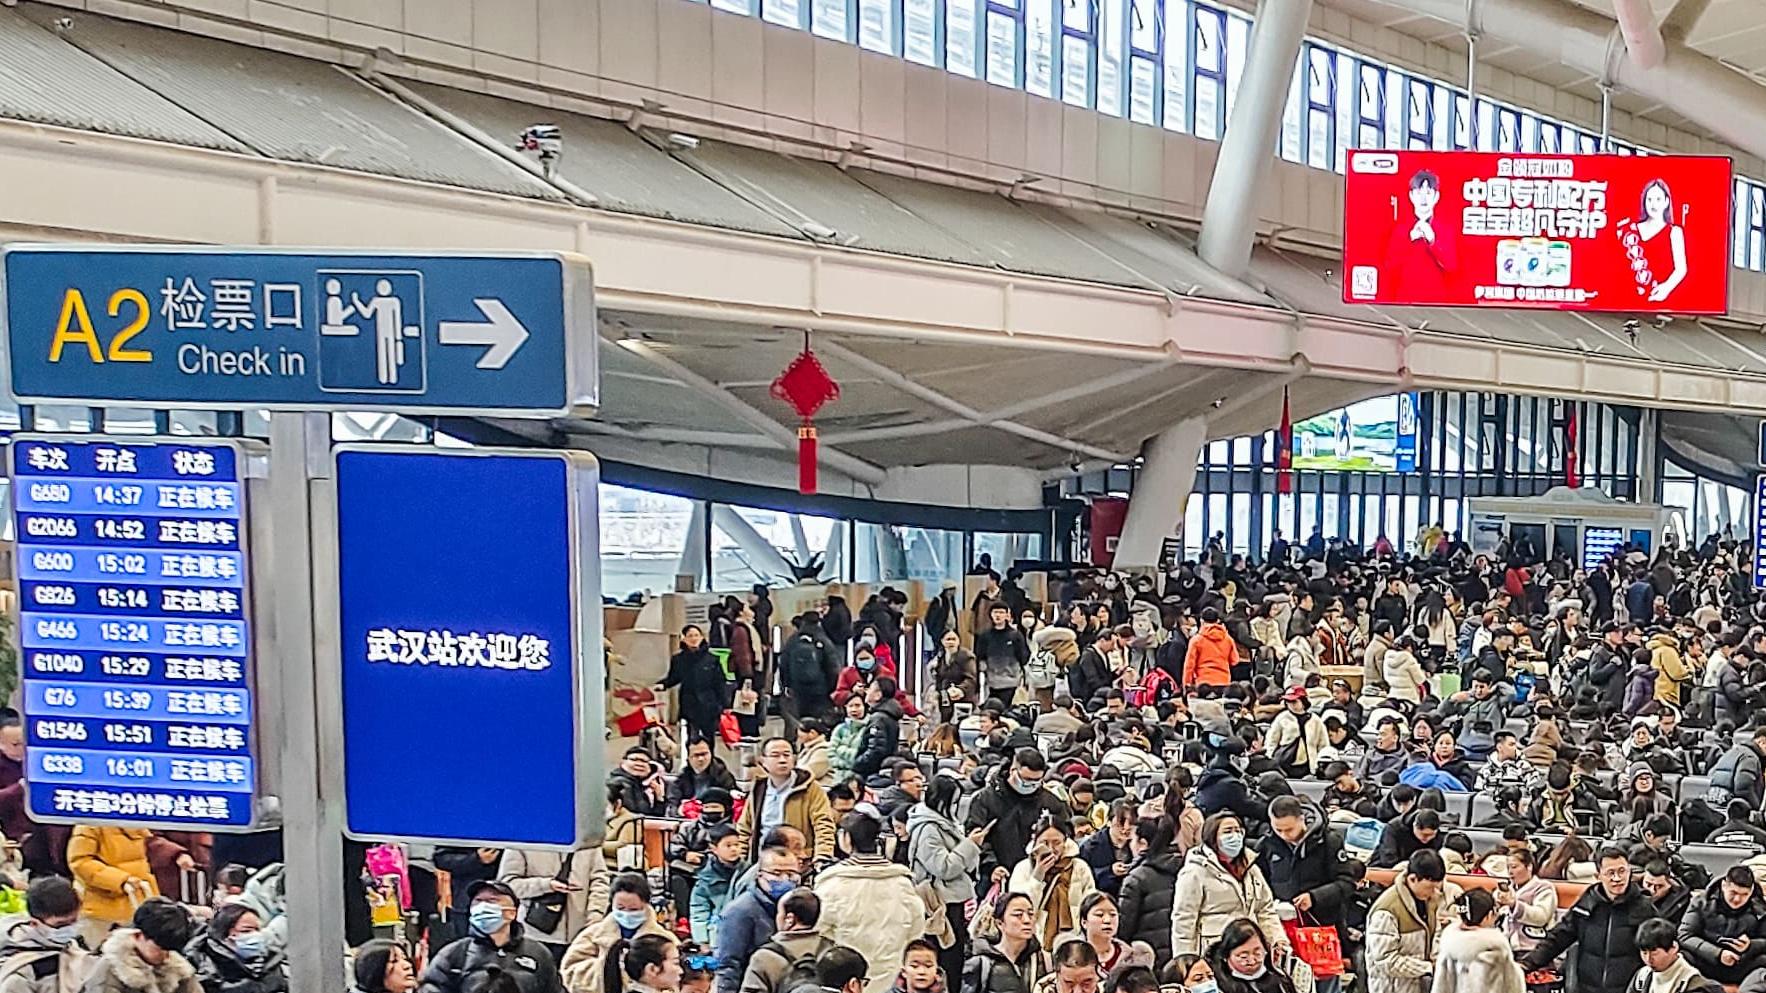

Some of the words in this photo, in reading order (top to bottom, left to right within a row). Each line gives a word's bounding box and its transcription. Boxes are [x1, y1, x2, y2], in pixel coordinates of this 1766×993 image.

[1463, 178, 1608, 210] 中国专利配方
[49, 288, 153, 363] A2
[160, 277, 303, 331] 检票口
[178, 343, 271, 375] Check
[279, 346, 305, 375] in
[28, 447, 69, 470] 车次
[96, 448, 137, 473] 开点
[172, 450, 215, 475] 状态
[94, 486, 143, 505] 14:37
[95, 519, 146, 539] 14:52
[97, 554, 146, 573] 15:02
[98, 588, 149, 608] 15:14
[101, 623, 149, 642] 15:24
[366, 628, 551, 670] 武汉站欢迎您
[101, 656, 151, 676] 15:29
[104, 723, 153, 744] 15:51
[106, 758, 153, 777] 16:01
